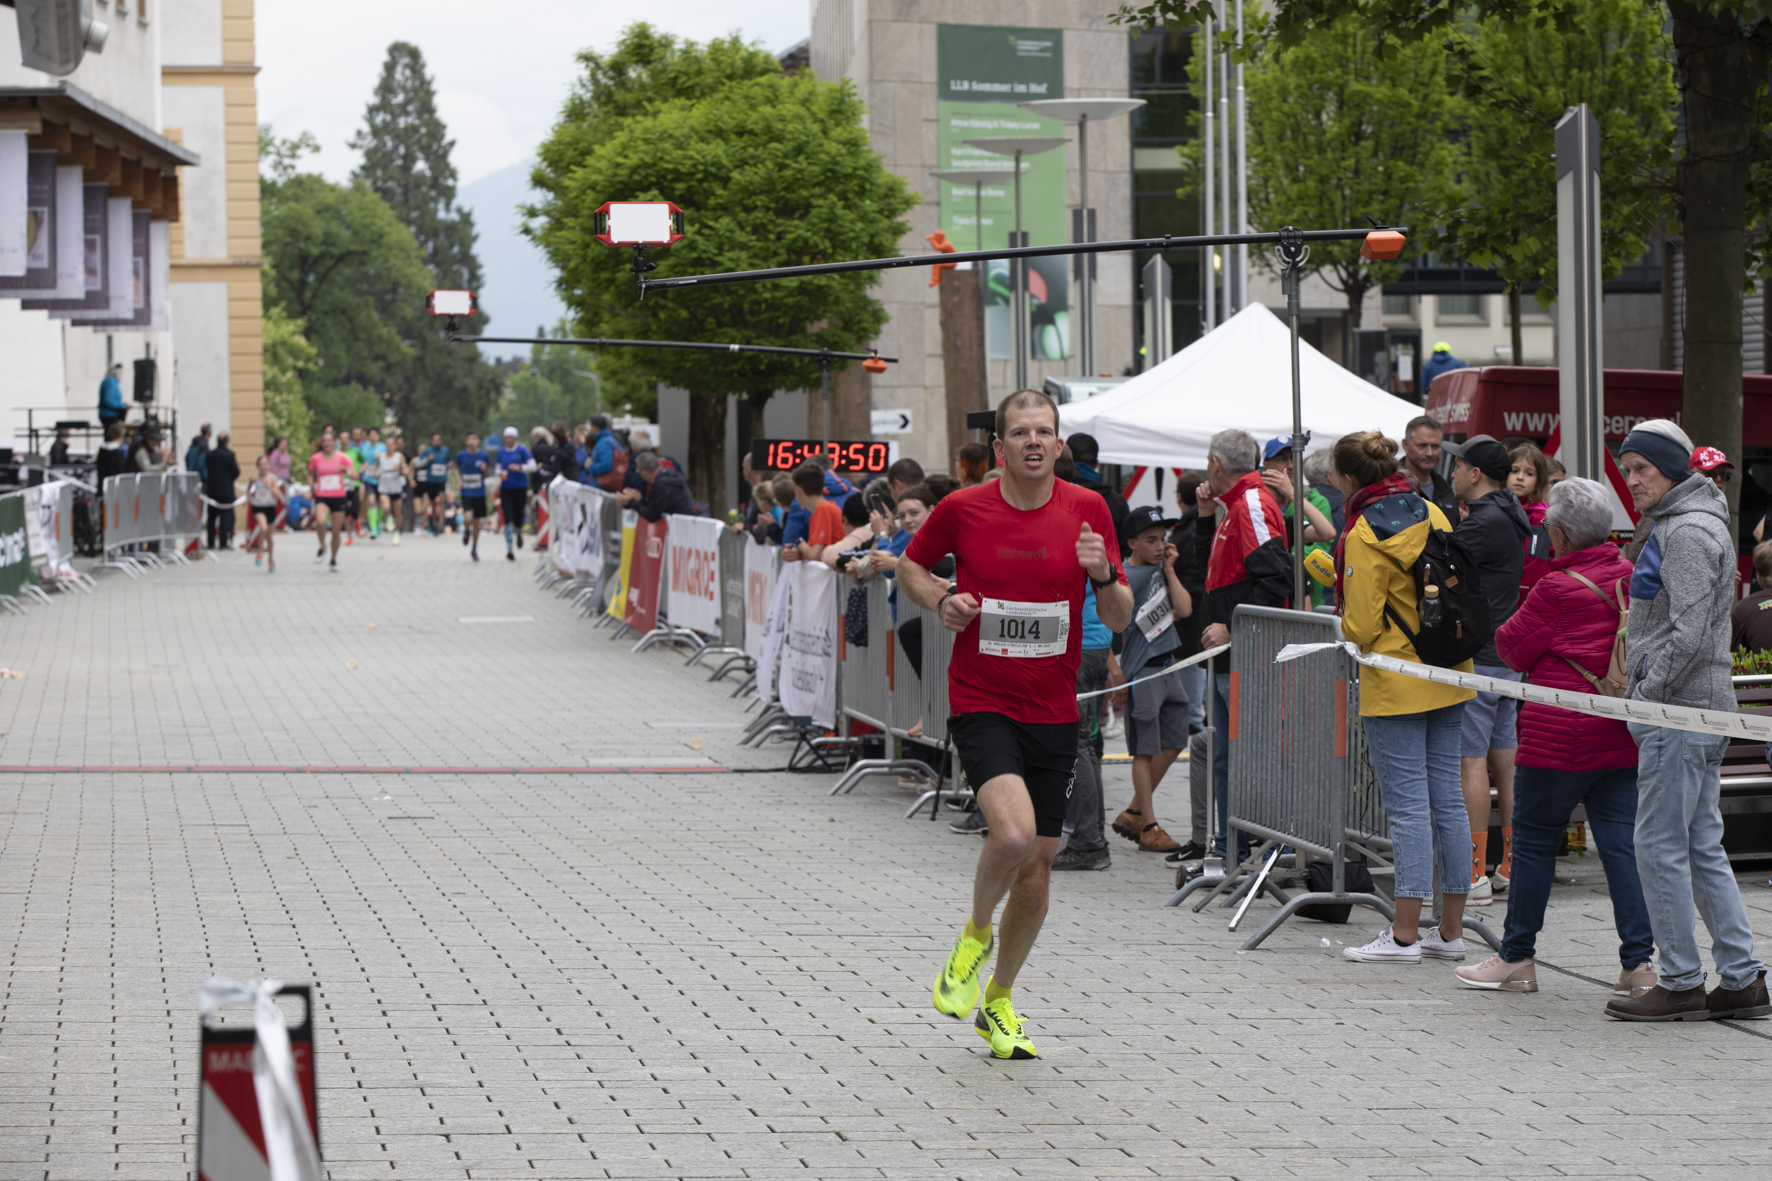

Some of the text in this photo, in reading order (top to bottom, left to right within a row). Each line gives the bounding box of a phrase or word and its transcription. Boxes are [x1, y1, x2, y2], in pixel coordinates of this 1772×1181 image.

[950, 80, 1048, 94] LLB Sommer im Hof
[1311, 558, 1332, 578] Radio
[1147, 602, 1169, 626] 1031
[999, 618, 1040, 640] 1014
